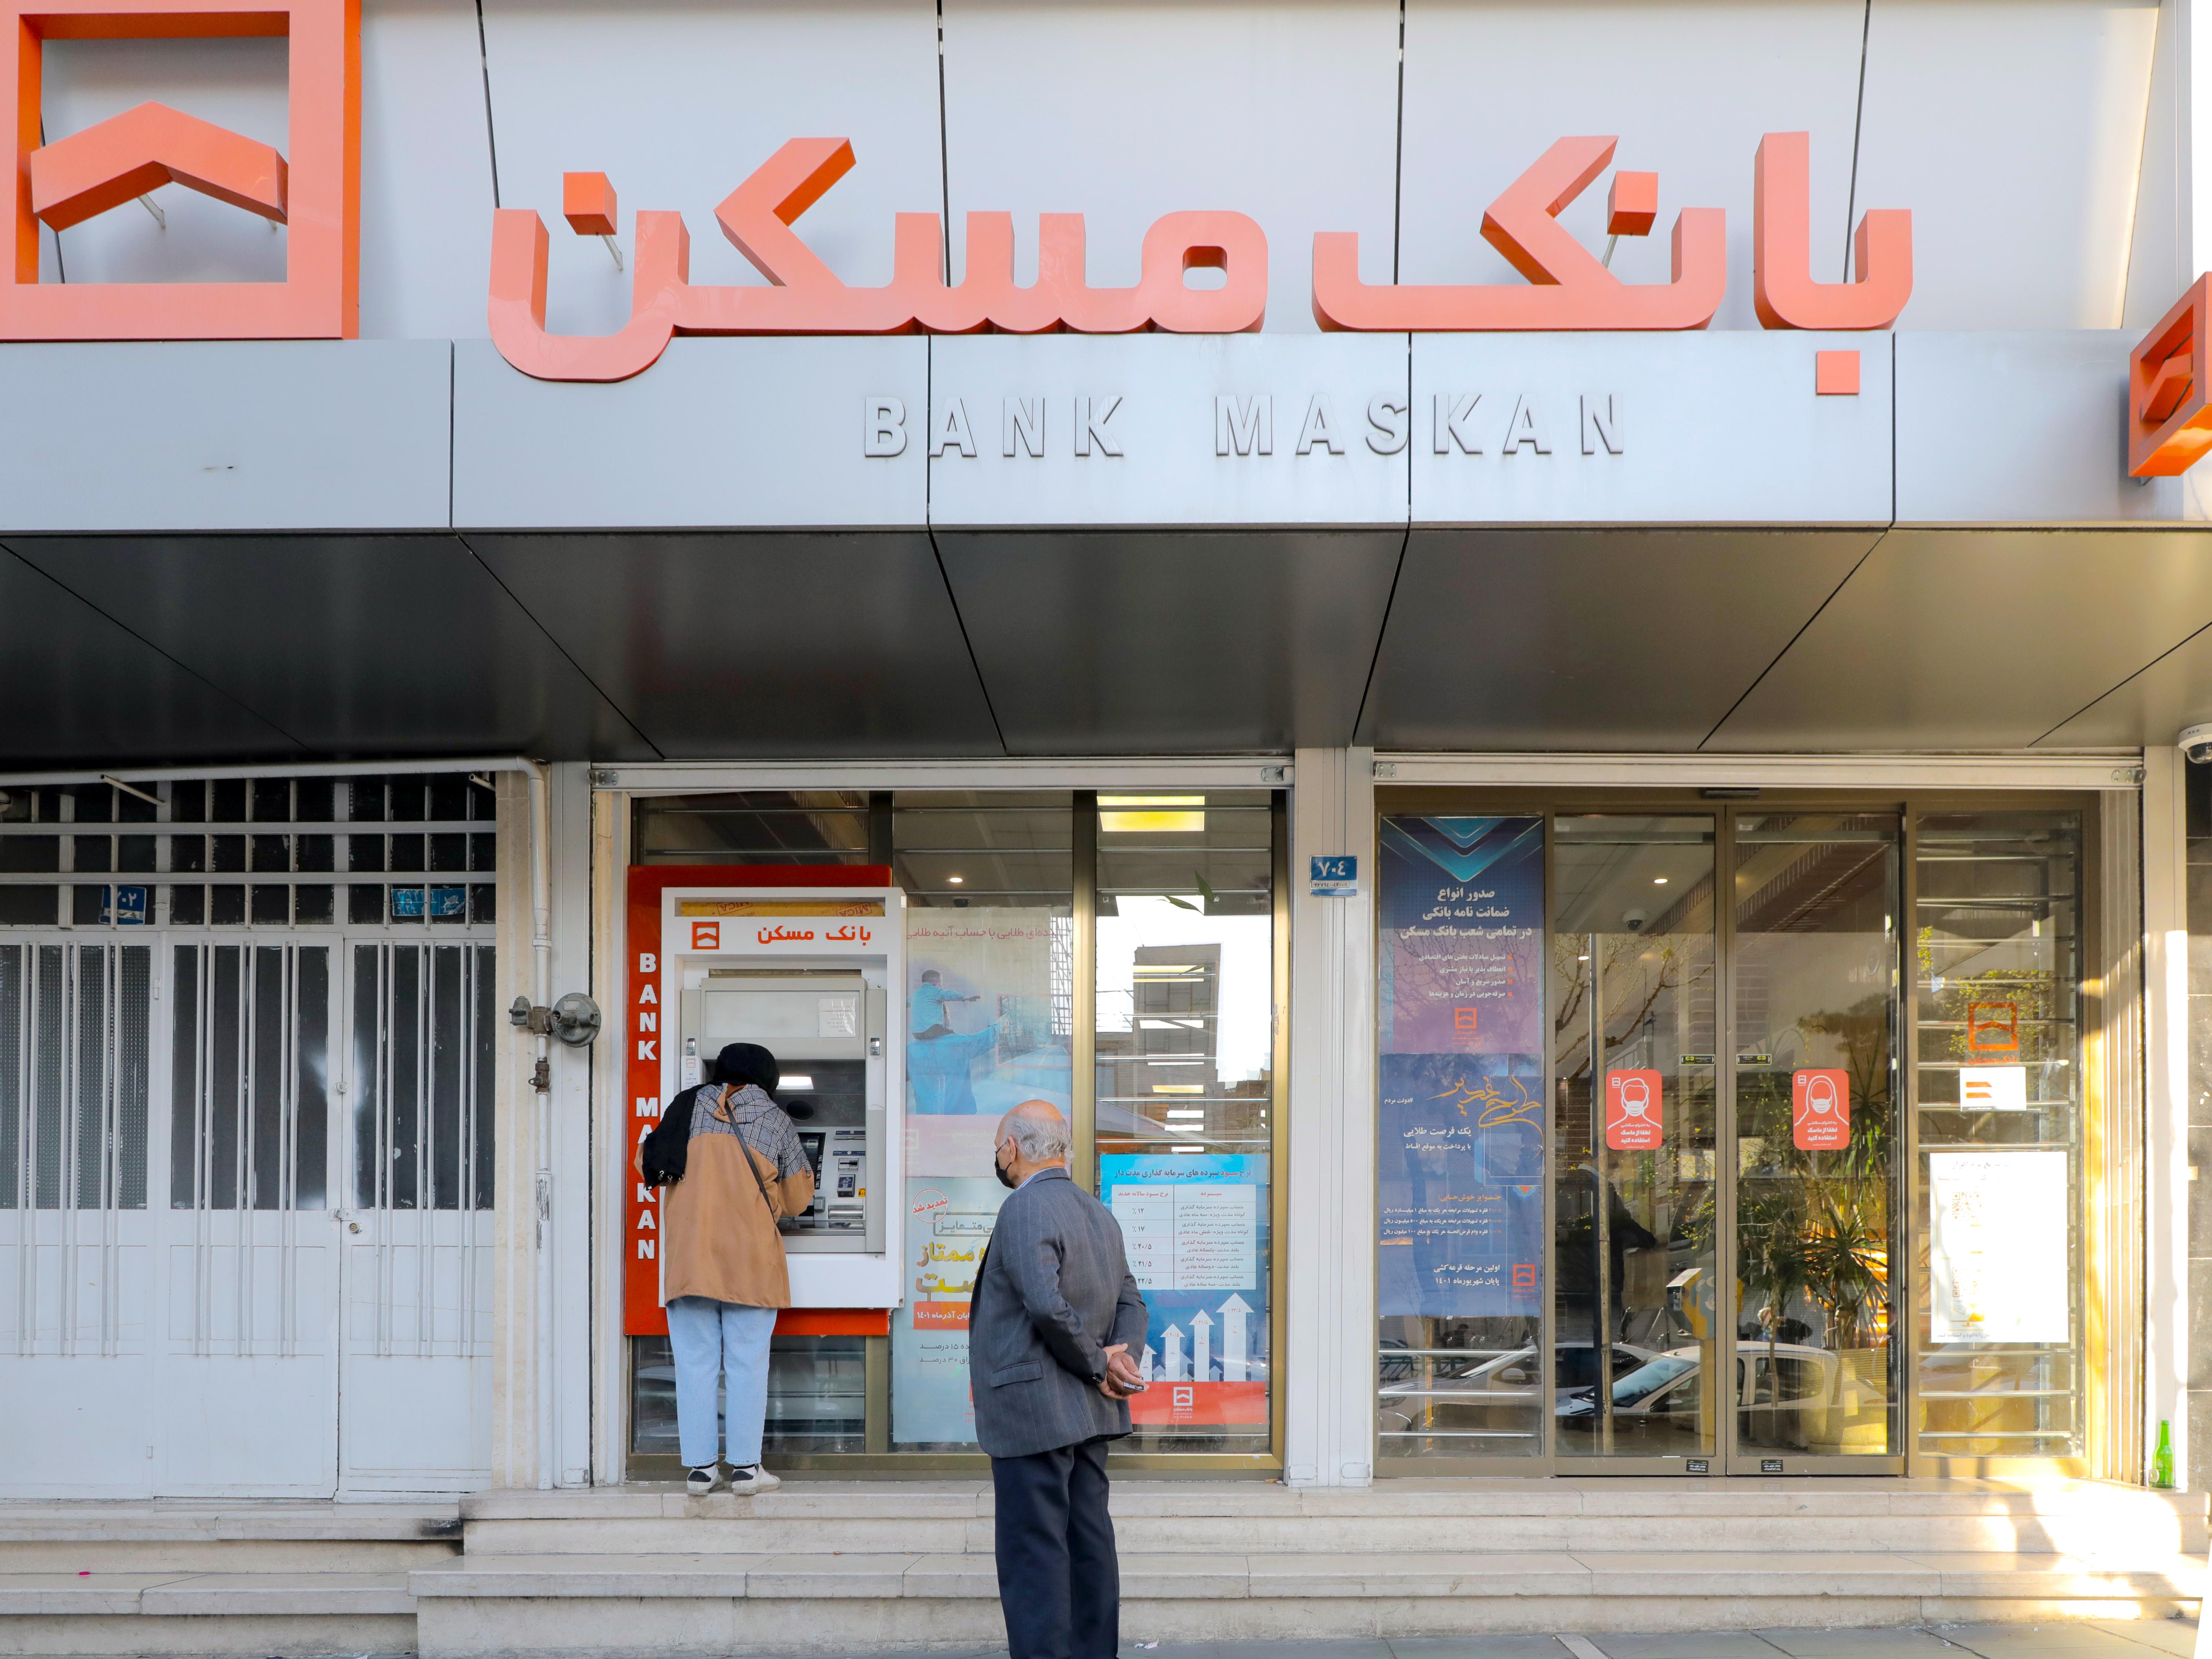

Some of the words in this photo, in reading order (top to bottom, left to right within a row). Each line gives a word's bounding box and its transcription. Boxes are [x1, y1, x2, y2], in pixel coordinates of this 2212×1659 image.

[487, 137, 1269, 383] مسکن
[1312, 131, 1914, 395] بانک
[864, 395, 1125, 457] BANK
[1214, 394, 1624, 456] MASKAN
[118, 891, 136, 906] ۰۲
[1437, 887, 1463, 902] انواع
[1466, 889, 1495, 902] صدور
[1423, 906, 1451, 920] بانکی
[1454, 906, 1473, 917] نامه
[1476, 907, 1510, 917] ضمانت
[758, 925, 814, 944] مسکن
[826, 926, 871, 946] بانک
[956, 928, 986, 939] حساب
[989, 928, 995, 939] با
[1400, 925, 1430, 939] مسکن
[1433, 925, 1457, 938] بانک
[1459, 926, 1484, 939] شعب
[1486, 925, 1517, 939] تمامی
[1519, 927, 1532, 939] در
[1456, 978, 1470, 986] آسان
[638, 953, 658, 1061] BANK
[1403, 1127, 1427, 1138] طلایی
[1430, 1127, 1455, 1138] فرصت
[1458, 1127, 1471, 1136] یک
[1422, 1143, 1435, 1151] موقع
[1443, 1143, 1464, 1151] پرداخت
[636, 1097, 658, 1259] MAKAN
[1164, 1169, 1184, 1178] سرمایه
[1186, 1169, 1199, 1178] های
[913, 1204, 925, 1214] شد
[926, 1198, 948, 1211] تمدید
[916, 1241, 975, 1267] ممتاز
[1484, 1265, 1500, 1273] اولین
[1453, 1277, 1483, 1286] شهریورماه
[1485, 1278, 1499, 1286] پایان
[932, 1311, 956, 1319] آذرماه
